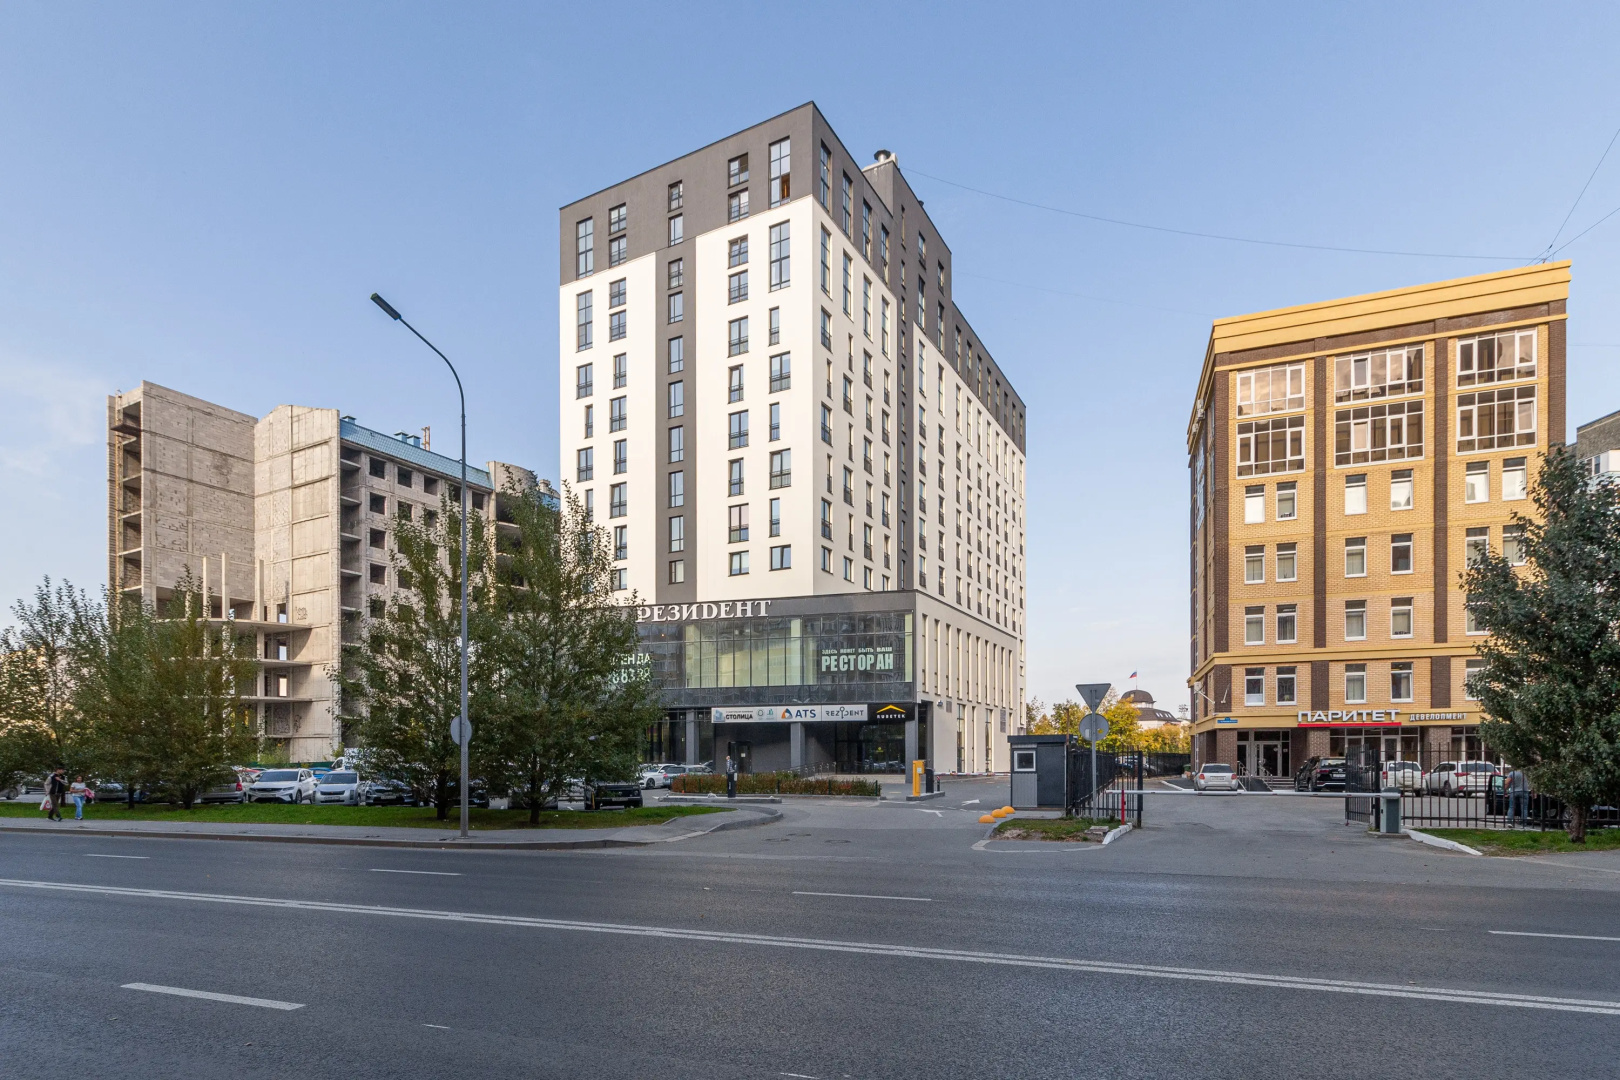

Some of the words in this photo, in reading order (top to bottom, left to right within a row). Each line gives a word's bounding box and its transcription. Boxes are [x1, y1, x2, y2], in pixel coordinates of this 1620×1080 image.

[821, 653, 893, 672] РЕСТОРАН
[725, 713, 754, 721] СТОЛИЦА
[794, 709, 817, 719] ATS
[1297, 709, 1401, 722] ПАРИТЕТ
[1409, 712, 1468, 721] ДЕВЕЛОПМЕНТ
